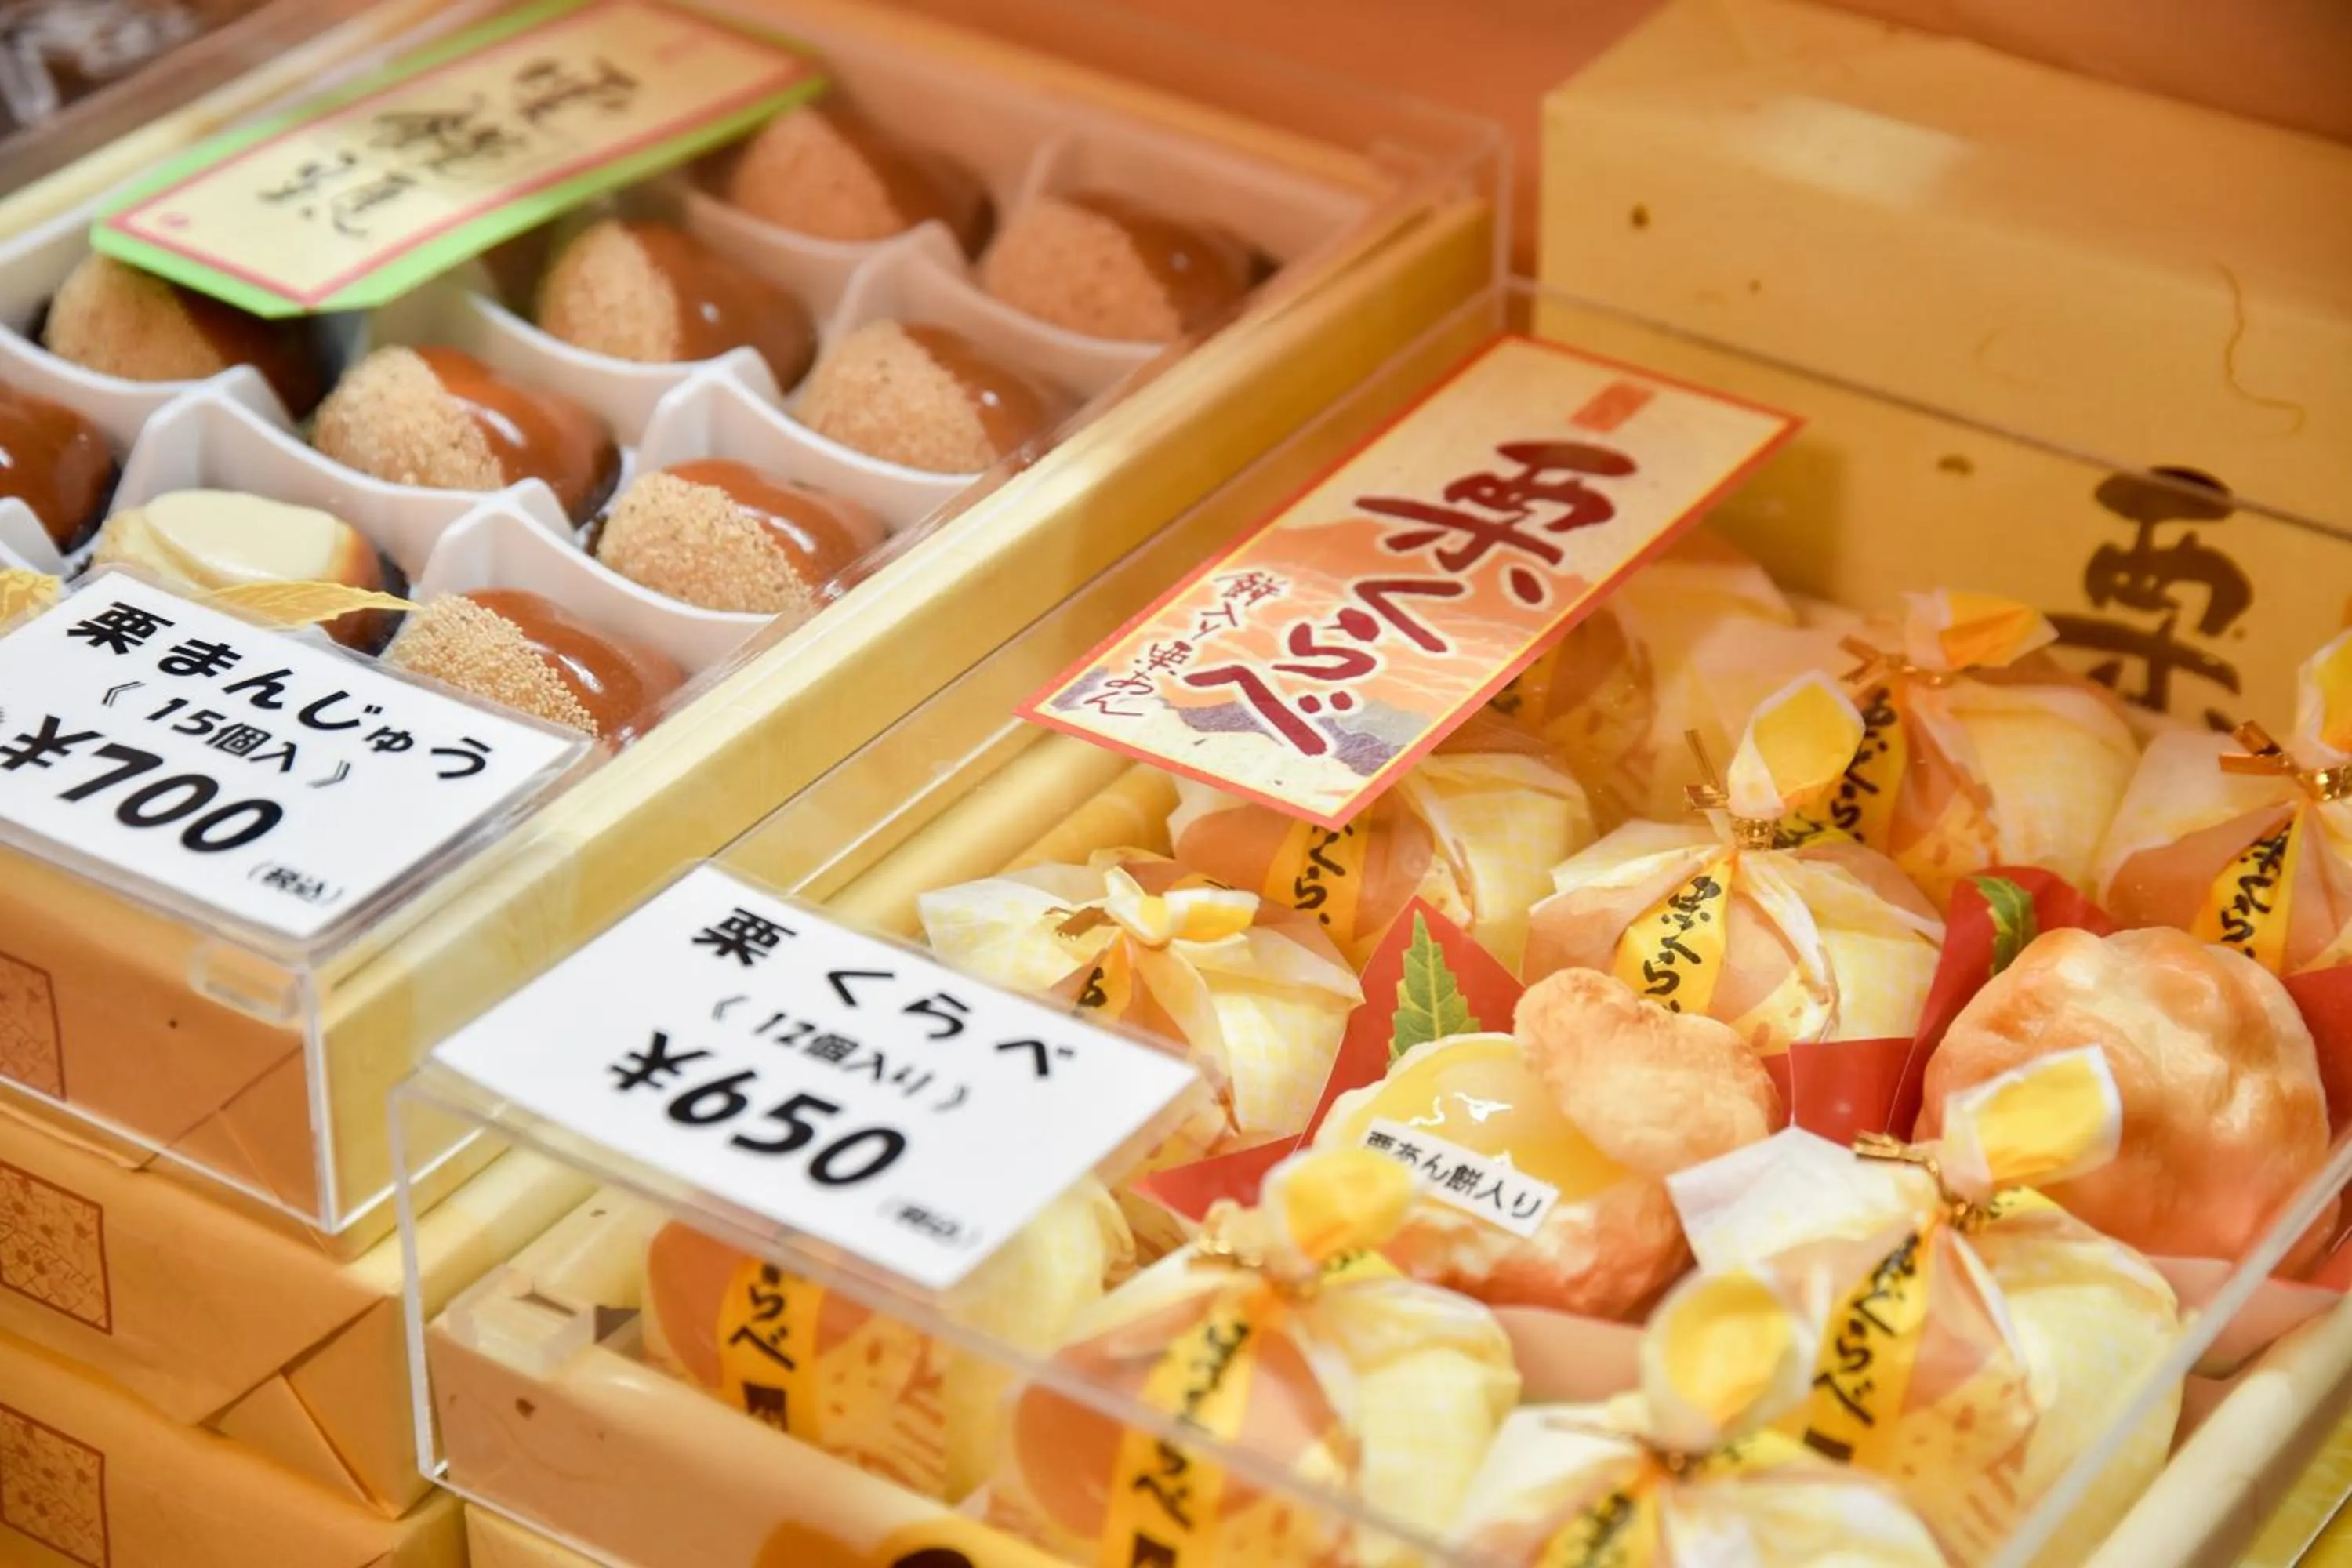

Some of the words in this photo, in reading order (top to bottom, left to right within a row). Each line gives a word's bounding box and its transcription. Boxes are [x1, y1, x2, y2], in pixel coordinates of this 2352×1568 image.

[1183, 439, 1638, 757] 栗くらべ
[67, 601, 493, 780] 栗まんじゅう
[0, 713, 284, 854] ¥700
[691, 906, 1075, 1077] 栗くらべ
[1642, 875, 1722, 1014] 栗くら
[607, 1029, 906, 1187] ¥650
